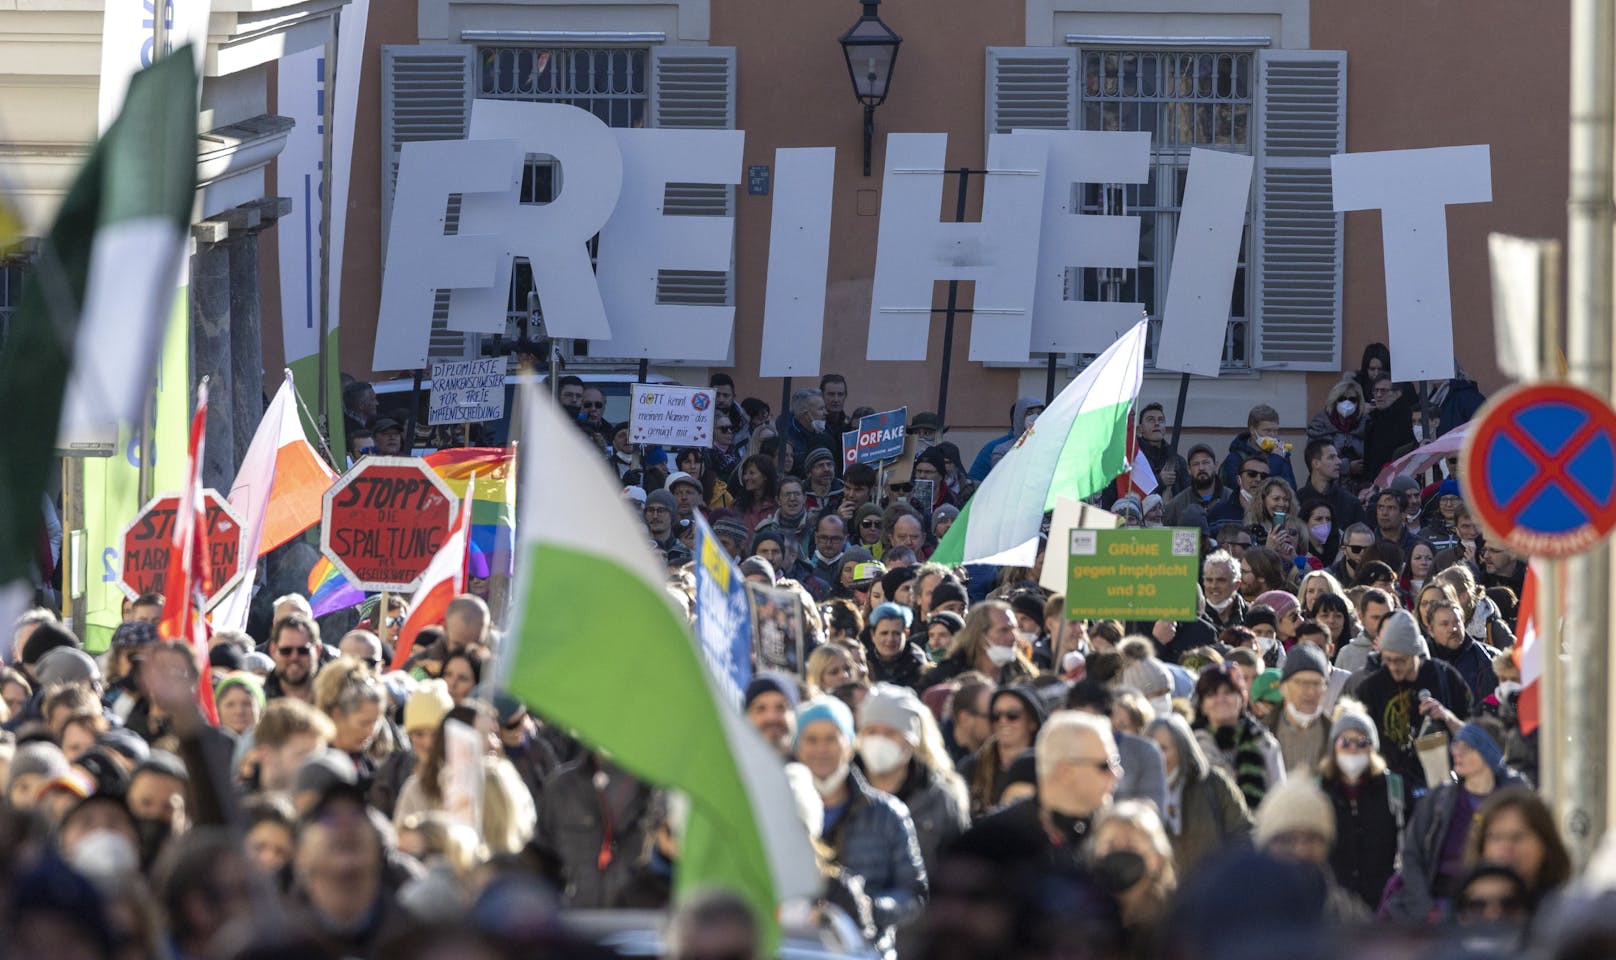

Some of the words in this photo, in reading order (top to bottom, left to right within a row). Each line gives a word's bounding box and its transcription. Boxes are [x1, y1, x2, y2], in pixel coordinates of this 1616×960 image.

[372, 99, 1492, 383] FREIHEIT
[666, 410, 690, 422] Namen
[860, 425, 905, 446] ORFAKE
[338, 477, 434, 511] STOPPT
[336, 526, 442, 560] SPALTUNG
[1108, 541, 1160, 556] GRÜNE
[1073, 565, 1116, 579] gegen
[1107, 583, 1134, 596] und
[1137, 583, 1156, 596] 2G
